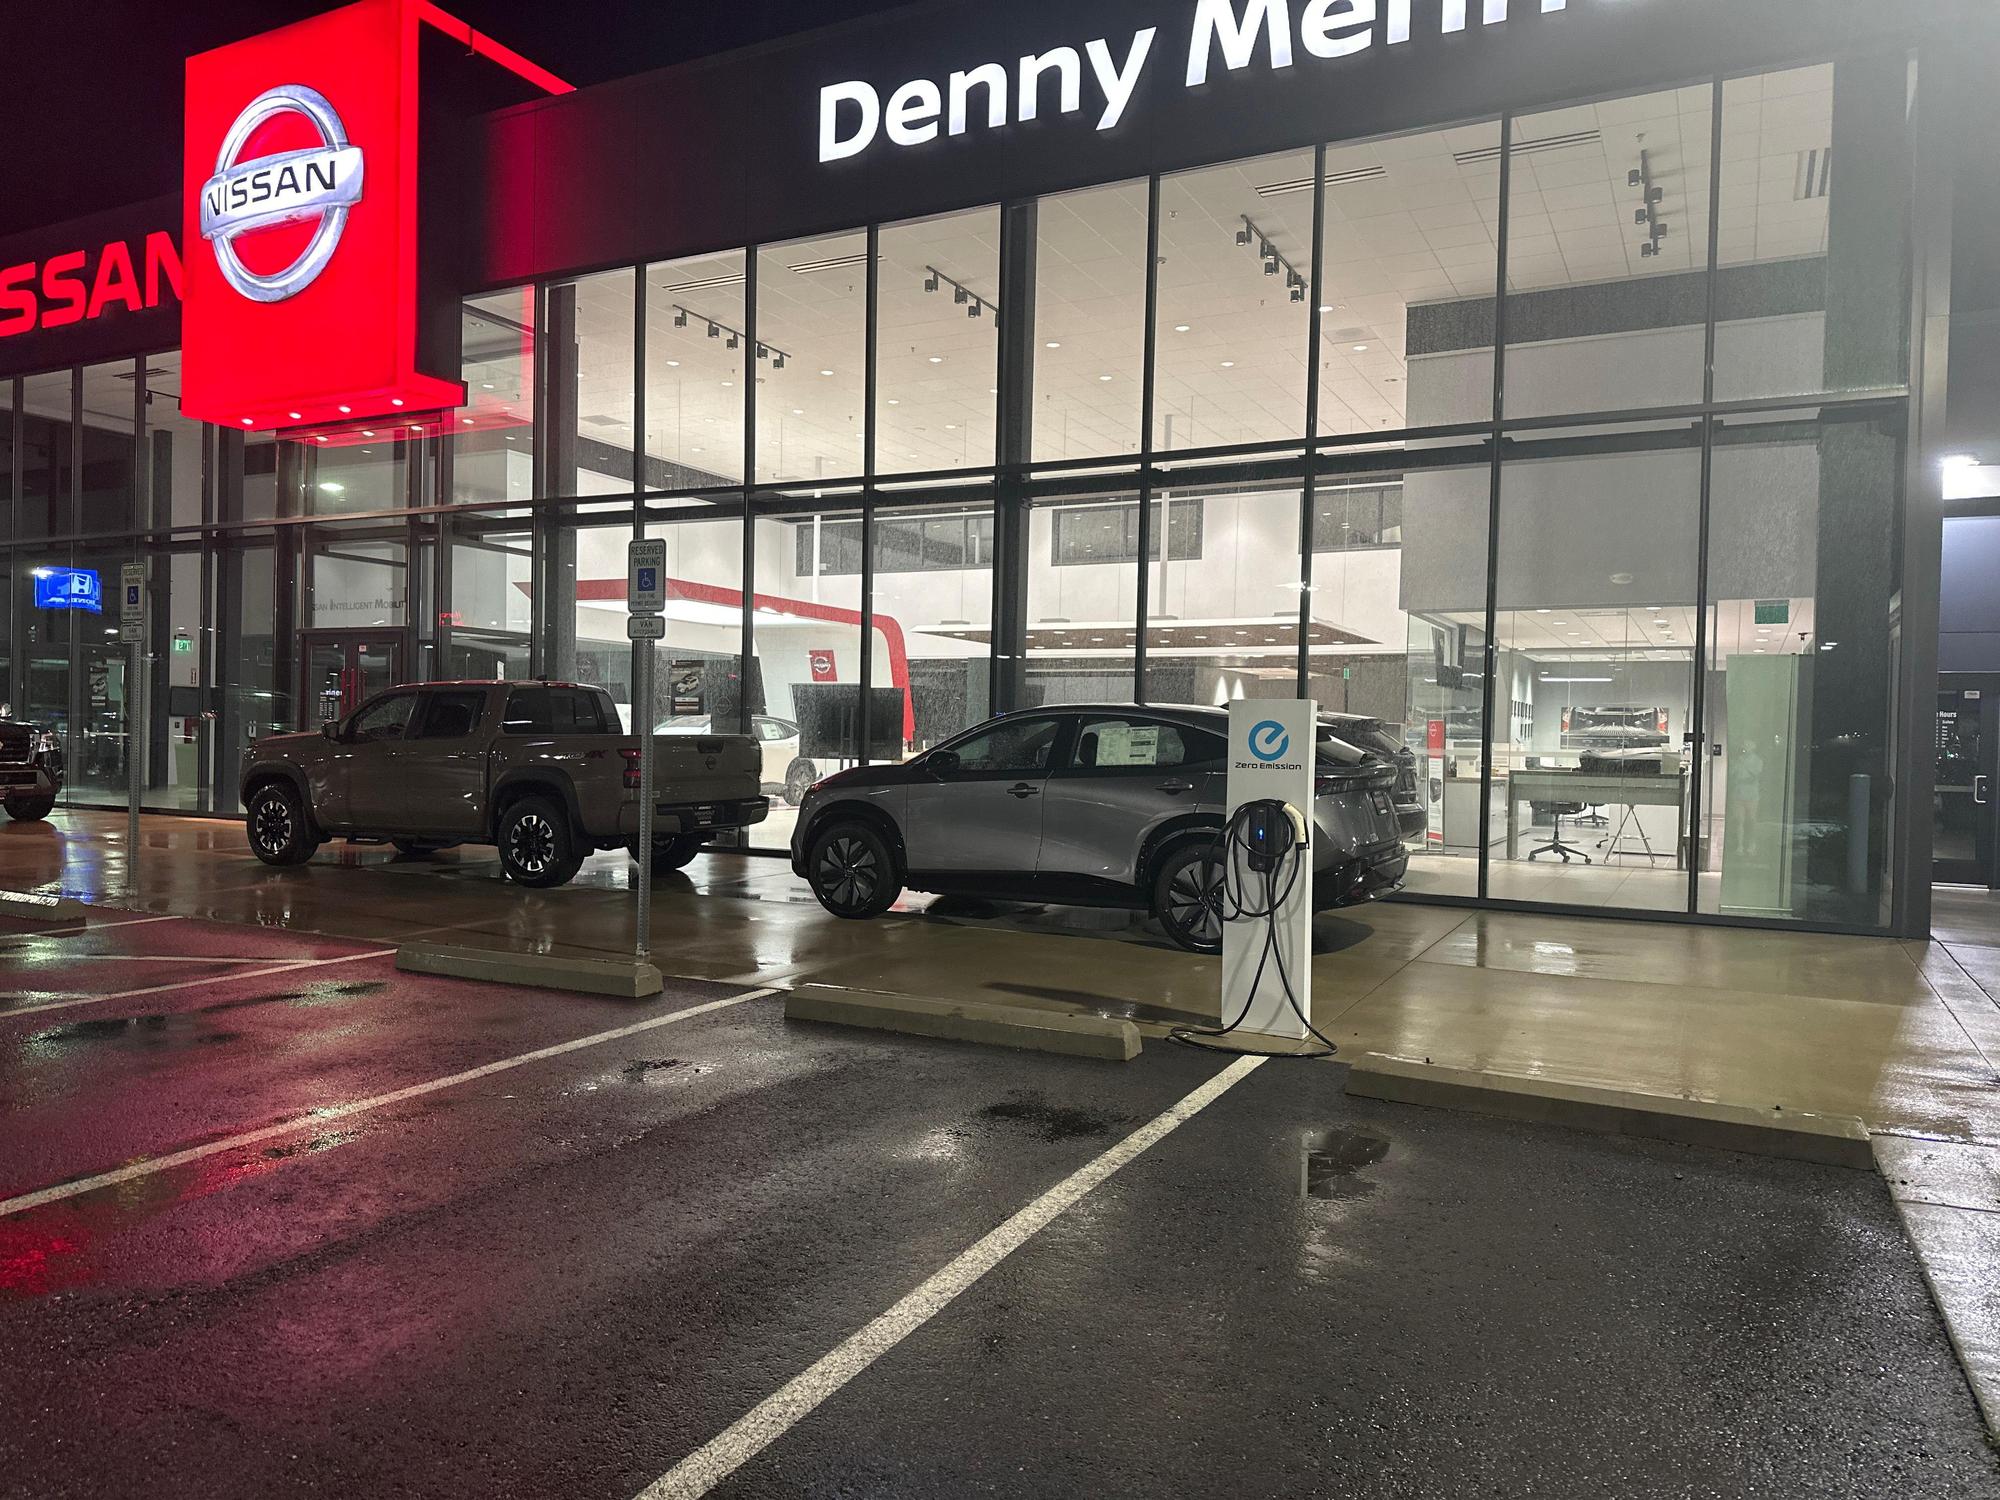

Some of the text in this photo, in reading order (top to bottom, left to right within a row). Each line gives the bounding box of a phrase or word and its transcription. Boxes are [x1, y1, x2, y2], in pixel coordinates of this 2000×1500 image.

[819, 27, 1157, 163] Denny
[206, 160, 336, 222] NISSAN
[630, 545, 664, 556] RESERVED
[633, 556, 661, 567] PARKING
[639, 620, 653, 628] VAN
